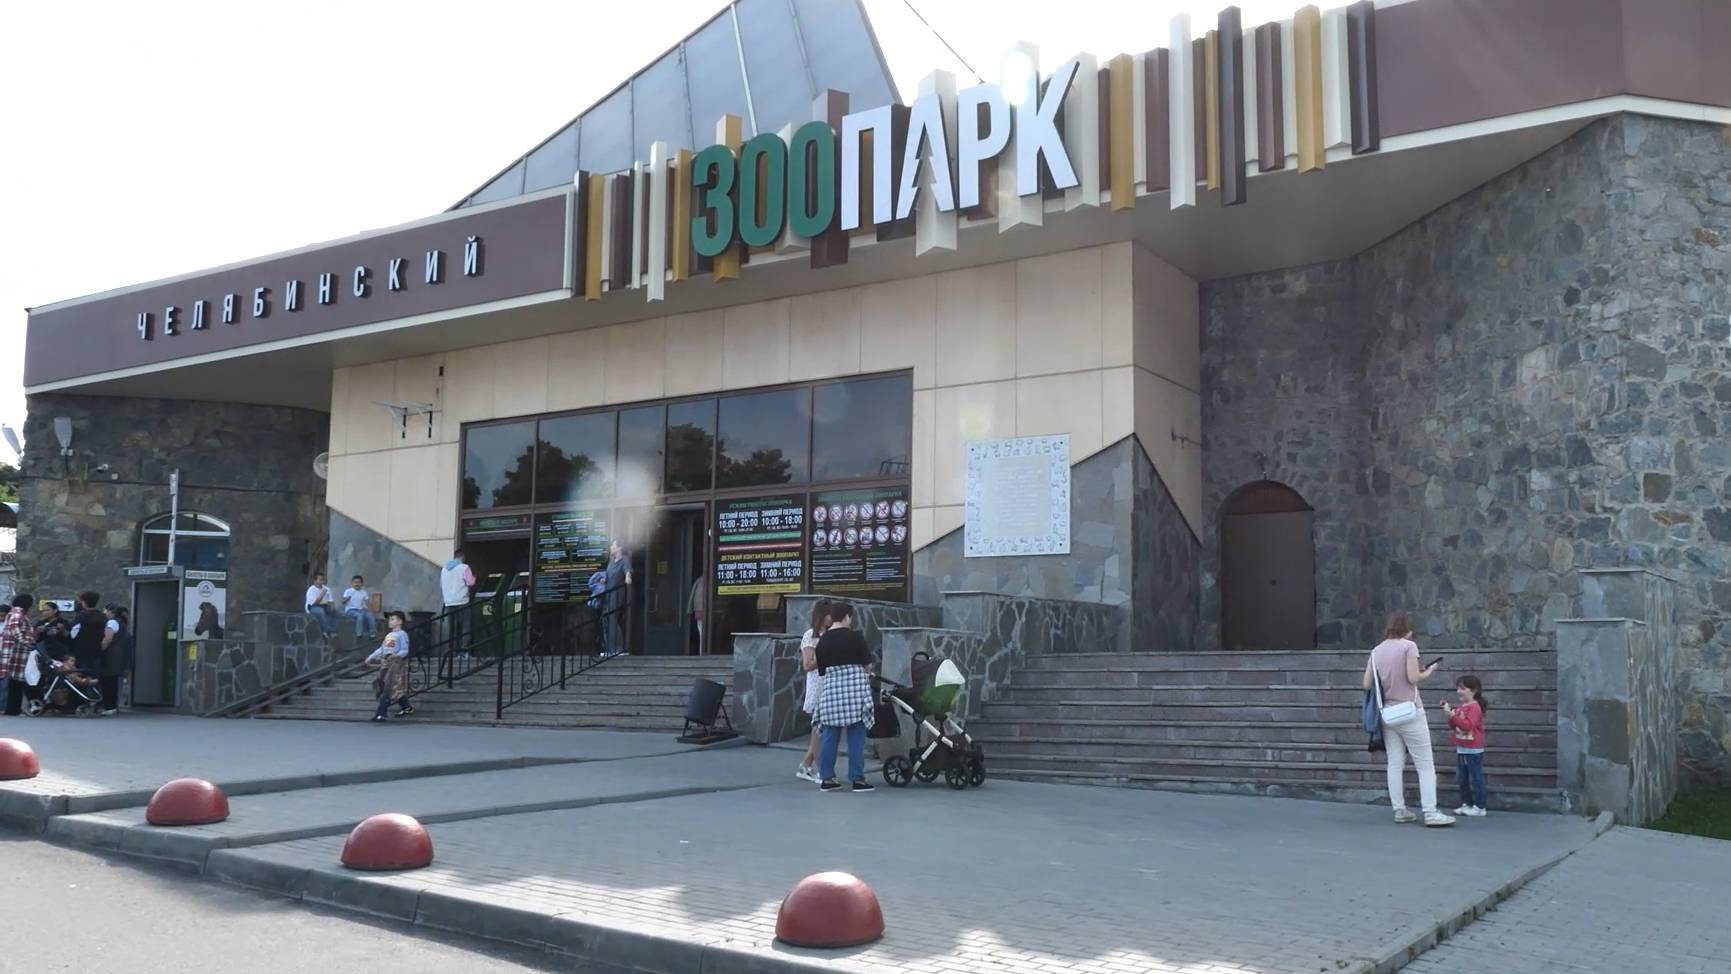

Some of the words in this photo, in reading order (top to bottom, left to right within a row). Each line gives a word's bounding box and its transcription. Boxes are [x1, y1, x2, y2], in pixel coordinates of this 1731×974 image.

[691, 61, 1080, 257] ЗООПАРК
[137, 235, 482, 340] ЧЕЛЯБИНСКИЙ
[719, 519, 736, 528] 10:00
[740, 518, 758, 527] 20:00
[761, 516, 779, 525] 10:00
[784, 515, 803, 524] 18:00
[718, 570, 734, 578] 11:00
[739, 569, 757, 577] 18:00
[761, 569, 778, 577] 11:00
[783, 567, 801, 576] 16:00
